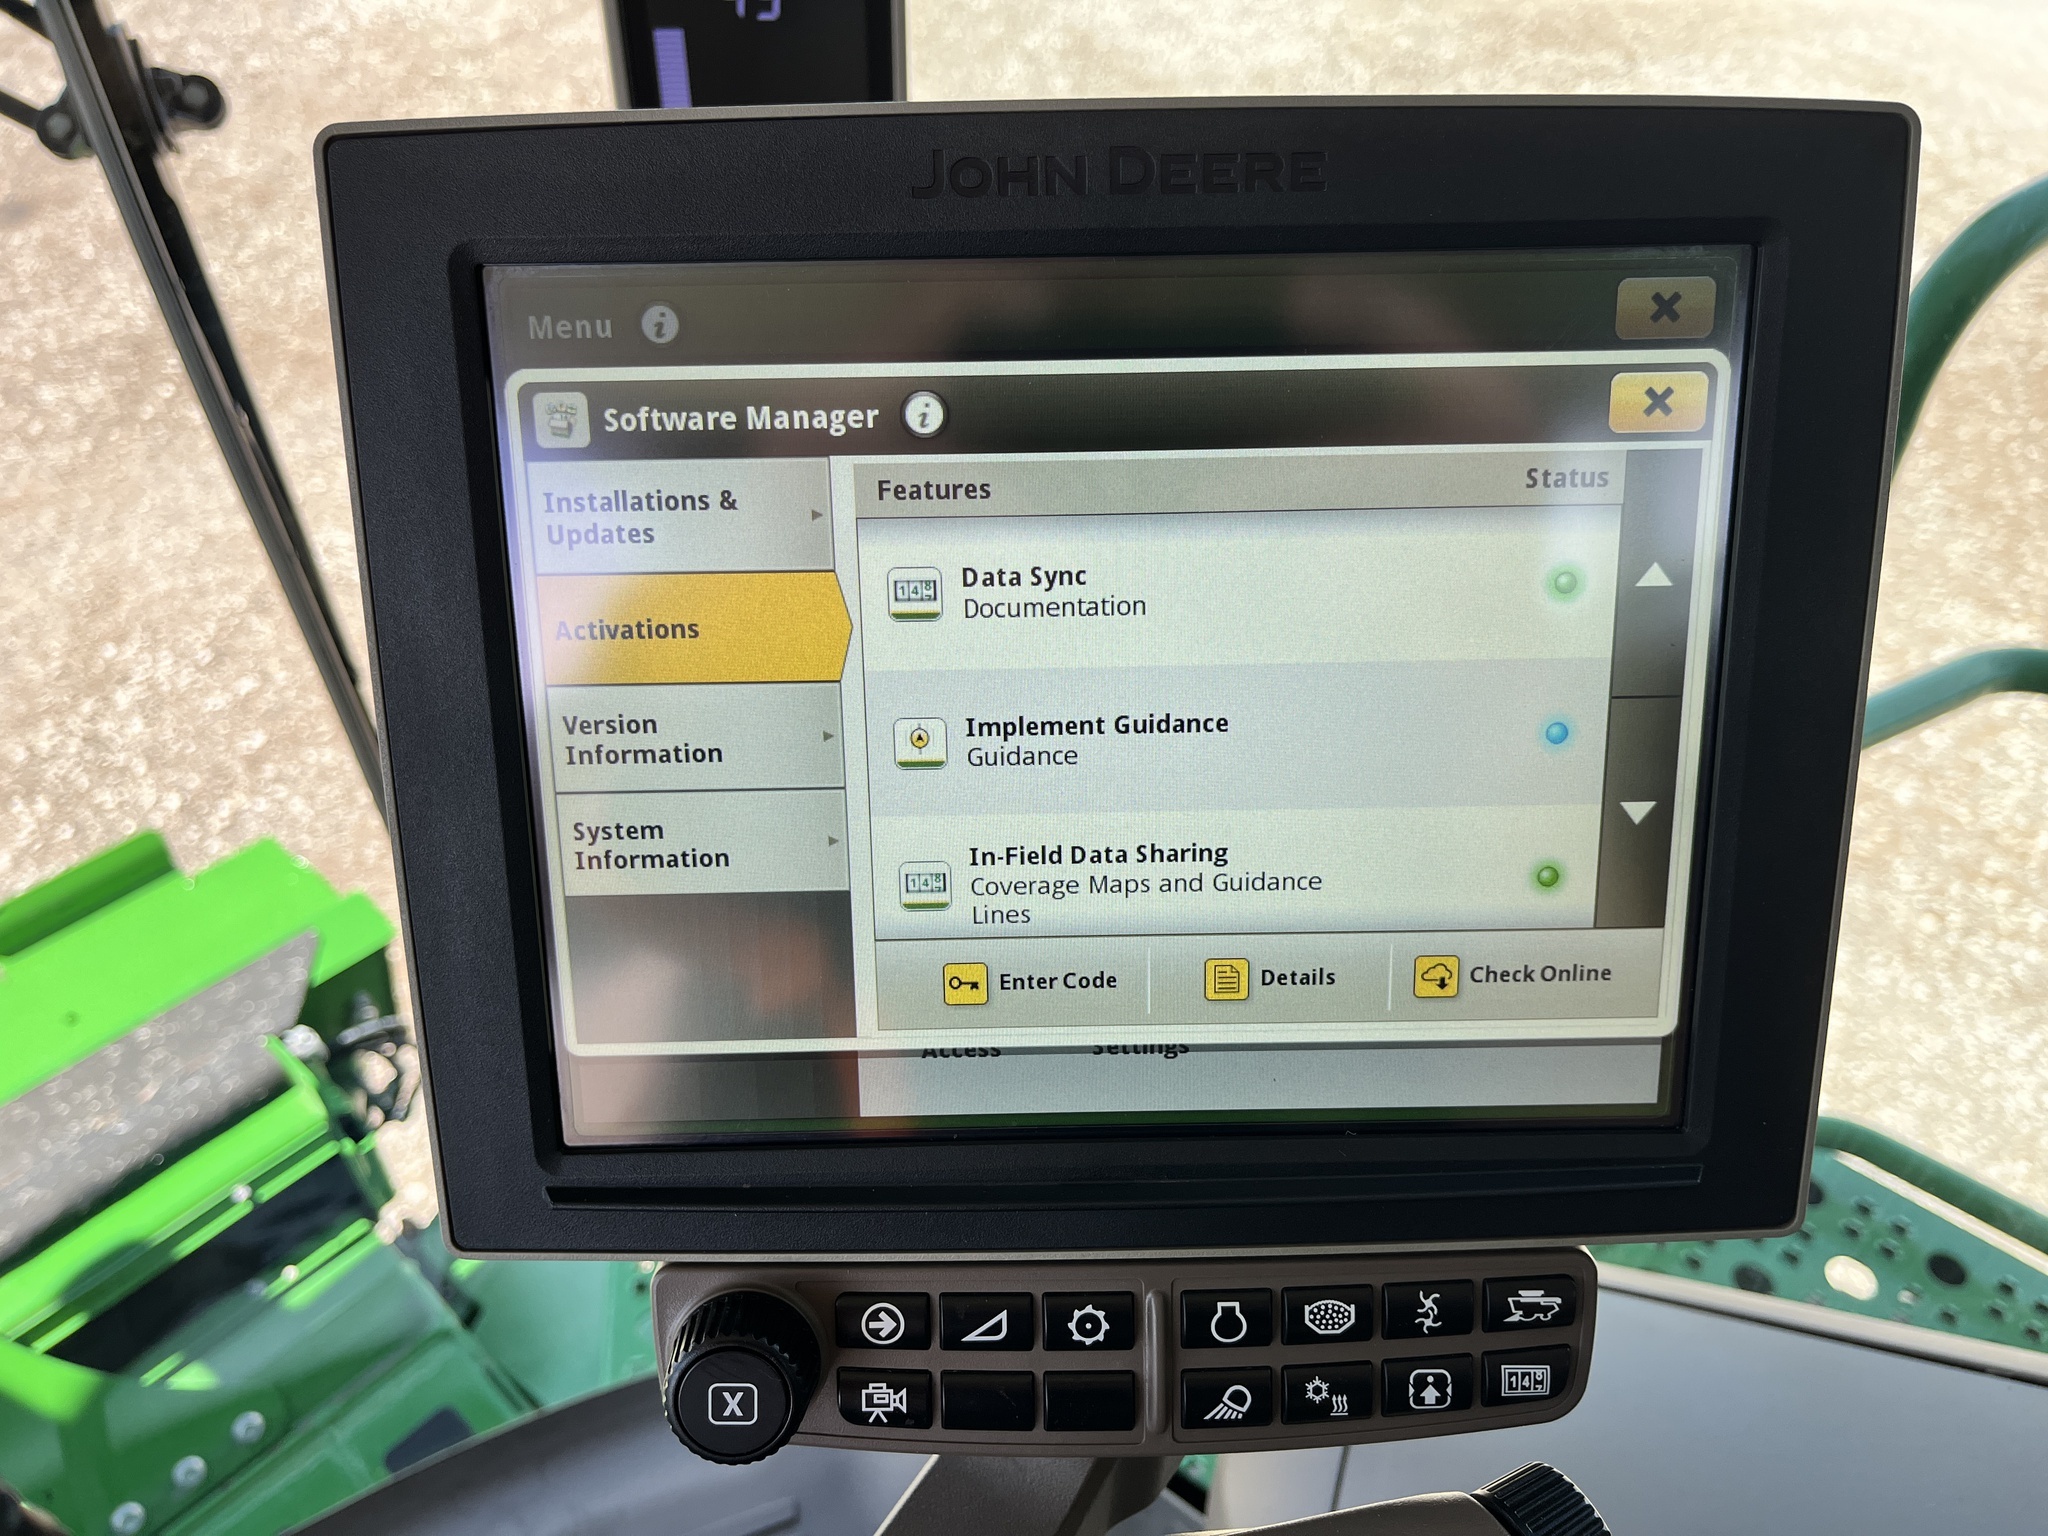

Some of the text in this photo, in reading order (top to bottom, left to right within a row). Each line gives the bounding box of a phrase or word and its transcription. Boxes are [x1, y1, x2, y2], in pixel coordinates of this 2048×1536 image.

[911, 145, 1329, 200] JOHN DEERE
[528, 314, 613, 340] Menu
[603, 404, 880, 437] Software Manager
[876, 478, 992, 501] Features
[1525, 467, 1609, 489] Status
[543, 489, 739, 514] Installations &
[546, 522, 655, 548] Updates
[961, 566, 1088, 592] Data Sync
[963, 594, 1147, 620] Documentation
[555, 618, 701, 642] Activations
[562, 712, 659, 737] Version
[965, 712, 1230, 742] Implement Guidance
[565, 743, 724, 766] Information
[966, 744, 1079, 768] Guidance
[572, 820, 665, 846] System
[574, 846, 731, 871] Information
[968, 842, 1230, 868] In-Field Data Sharing
[970, 868, 1324, 899] Coverage Maps and Guidance
[972, 904, 1032, 926] Lines
[998, 968, 1119, 992] Enter Code
[1261, 966, 1337, 988] Details
[1469, 960, 1613, 984] Check Online
